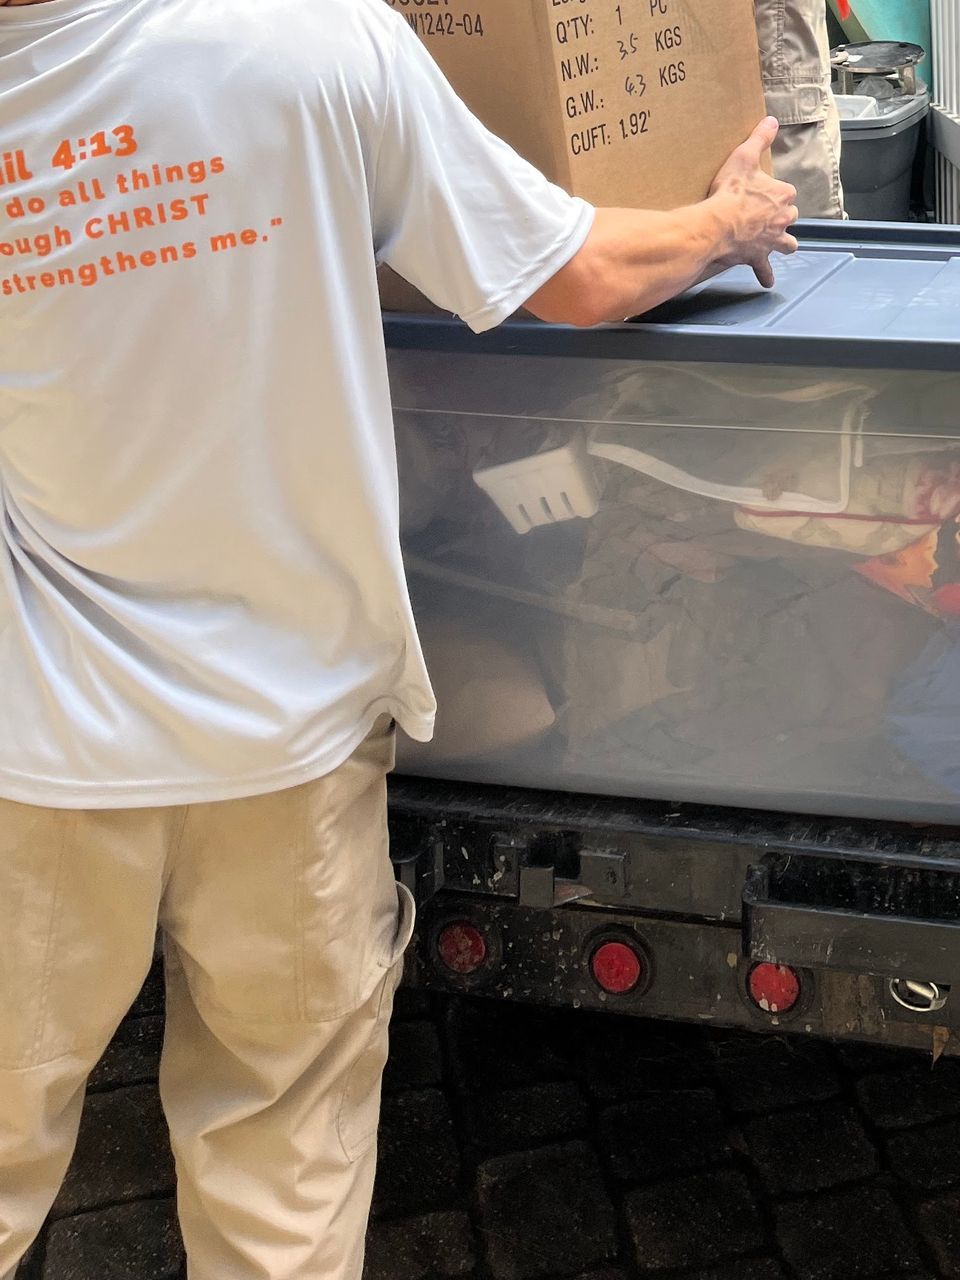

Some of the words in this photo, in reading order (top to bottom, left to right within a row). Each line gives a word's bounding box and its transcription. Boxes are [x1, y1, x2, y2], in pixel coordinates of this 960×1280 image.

[615, 4, 623, 26] 1
[560, 52, 599, 82] N.W.:
[654, 25, 682, 52] KGS
[566, 90, 604, 118] G.W.:
[659, 61, 686, 88] KGS
[0, 149, 33, 186] il
[51, 124, 138, 170] 4:13
[571, 123, 611, 156] CUFT:
[5, 196, 45, 219] do
[58, 178, 106, 208] all
[116, 156, 225, 195] things
[85, 193, 209, 240] CHRIST
[2, 241, 197, 296] strengthens
